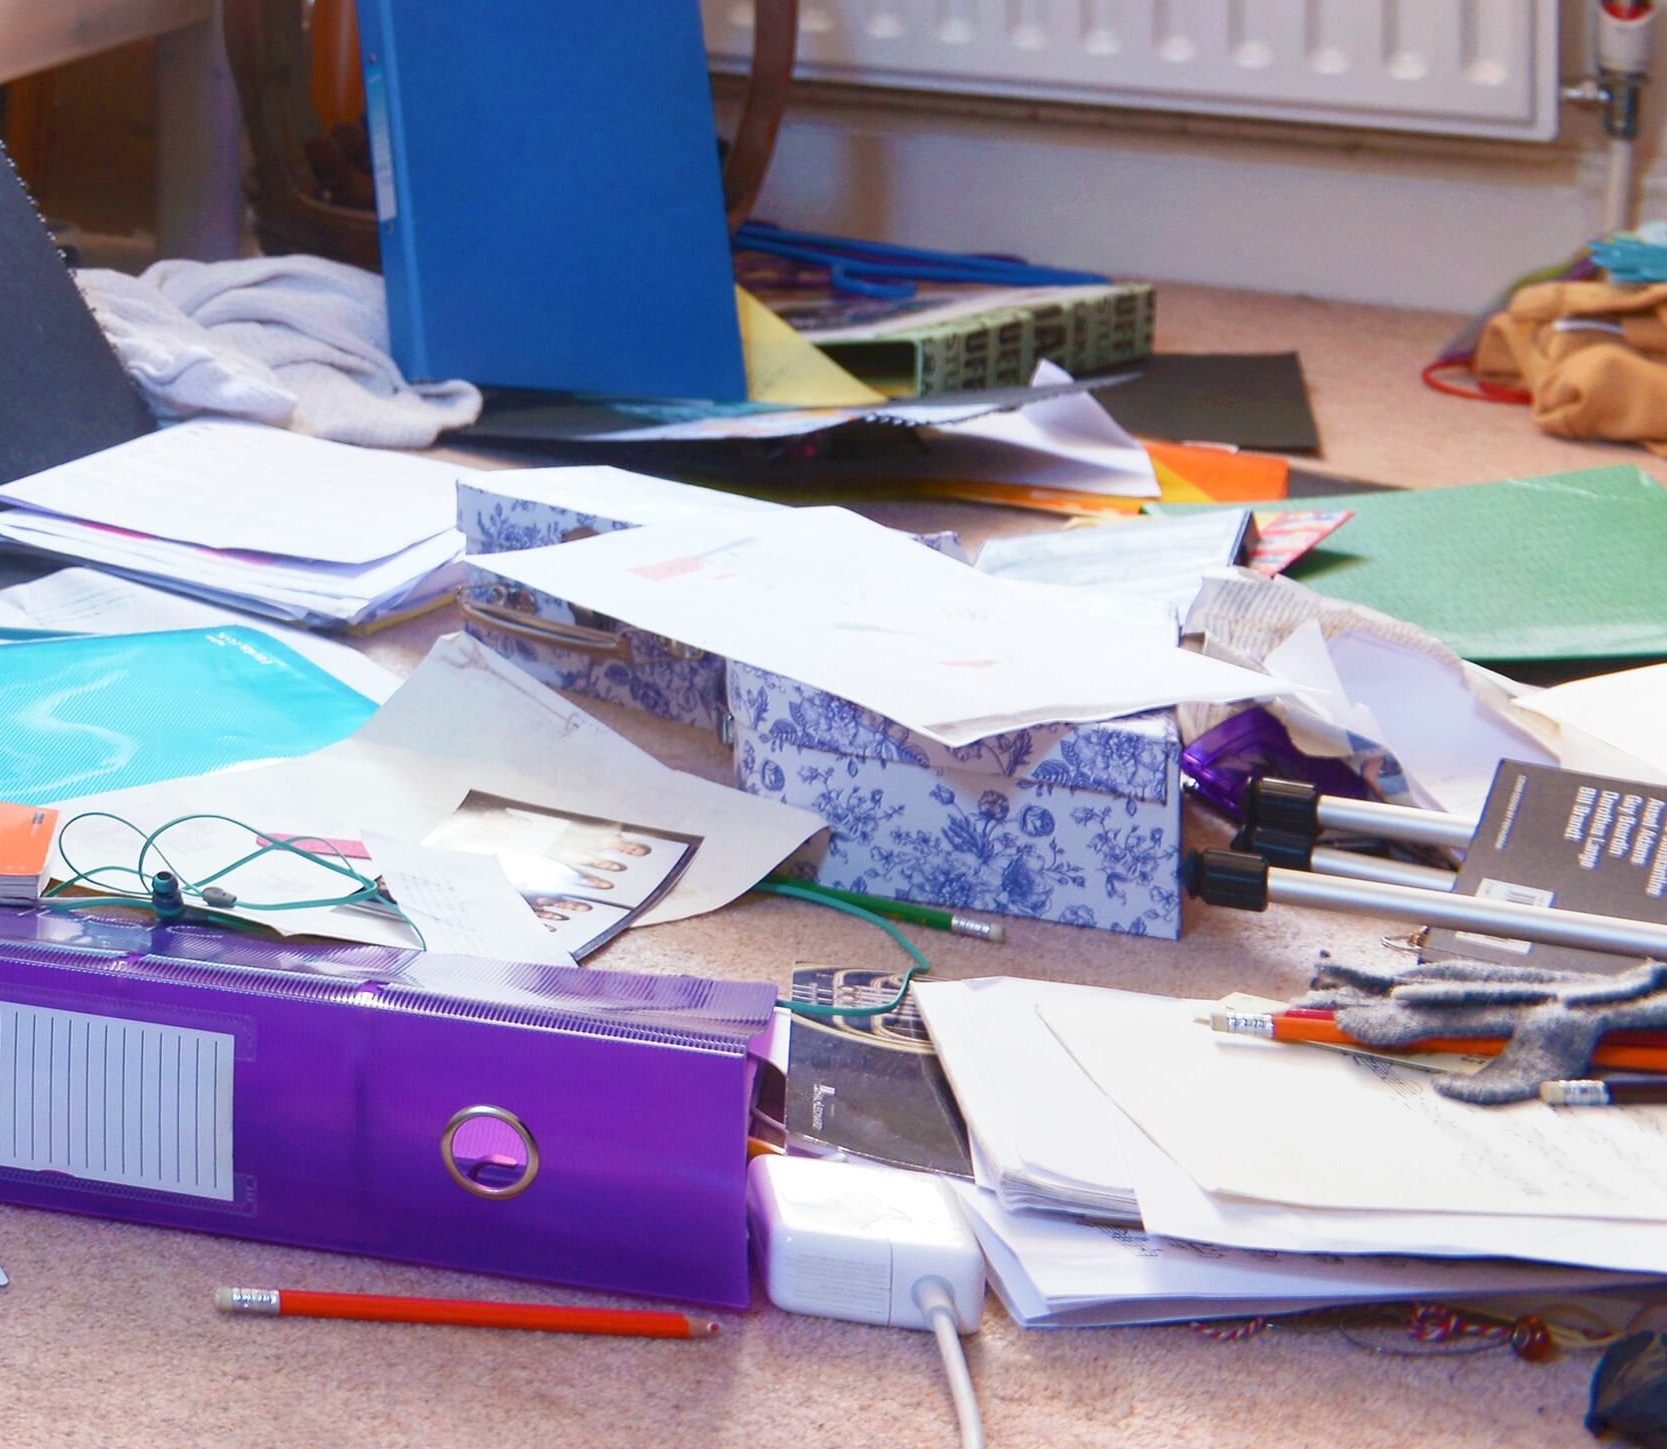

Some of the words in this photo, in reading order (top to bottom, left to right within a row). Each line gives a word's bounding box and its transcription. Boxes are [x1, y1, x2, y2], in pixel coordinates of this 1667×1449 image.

[1575, 785, 1598, 805] Bill
[1618, 794, 1643, 816] Guy
[1641, 796, 1666, 828] Ansel
[1564, 804, 1592, 842] Brandt
[1589, 790, 1620, 837] Dorothea
[1578, 836, 1607, 869] Lange
[1608, 814, 1637, 858] Bourdin
[1630, 827, 1658, 866] Adams
